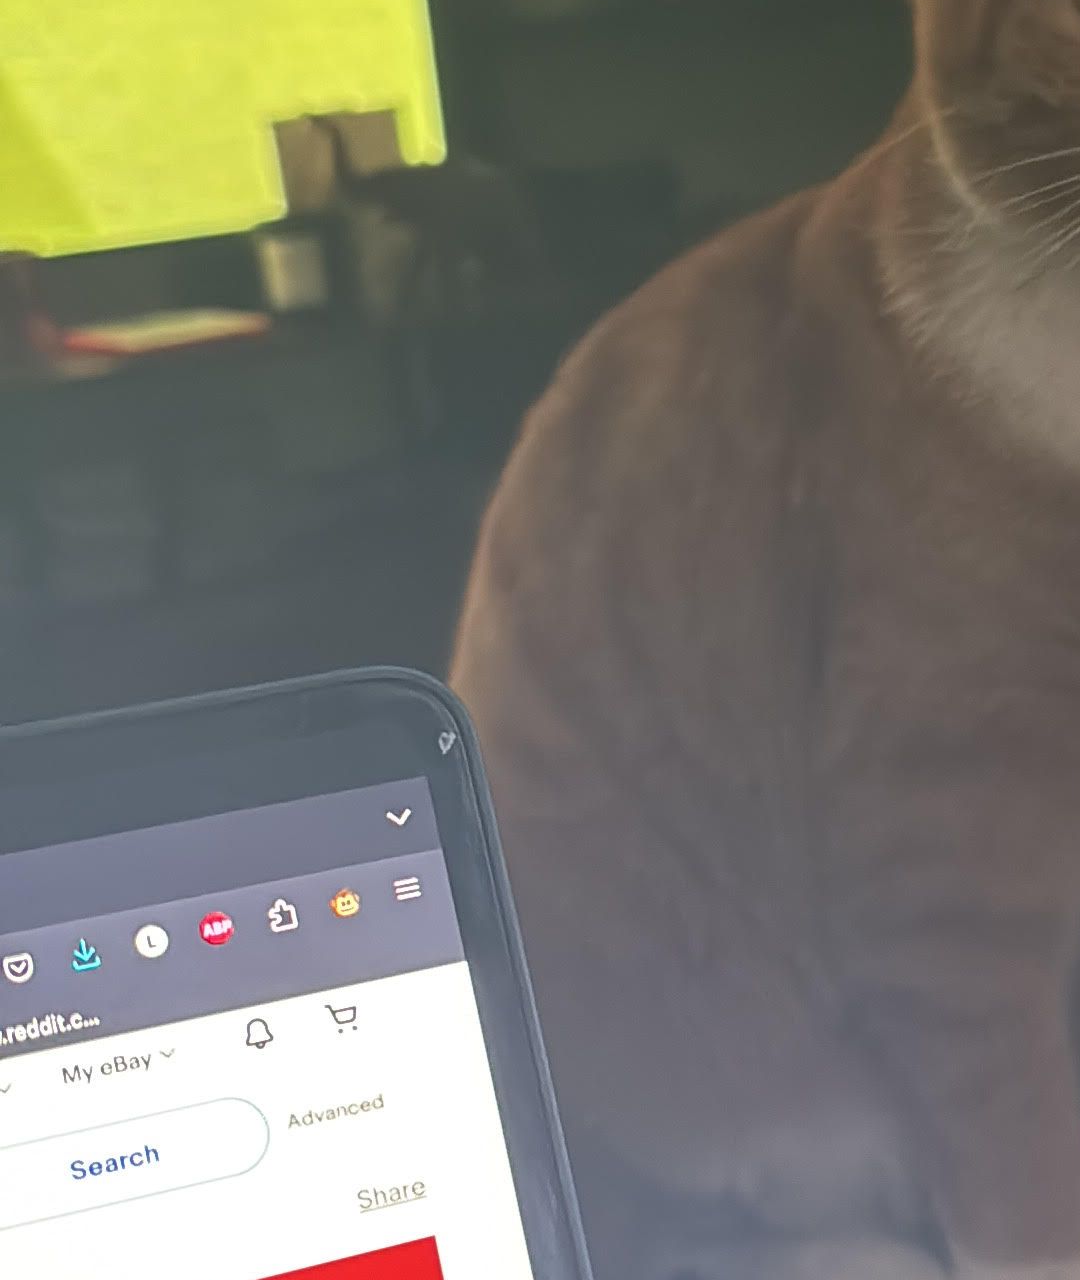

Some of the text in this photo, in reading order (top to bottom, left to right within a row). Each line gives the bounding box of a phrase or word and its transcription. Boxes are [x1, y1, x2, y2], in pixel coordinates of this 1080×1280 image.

[146, 935, 157, 949] L
[203, 918, 233, 938] ABP
[0, 1012, 101, 1047] .reddit.c...
[61, 1054, 151, 1084] My eBay
[288, 1094, 384, 1128] Advanced
[71, 1146, 159, 1179] Search
[358, 1182, 426, 1208] Share
